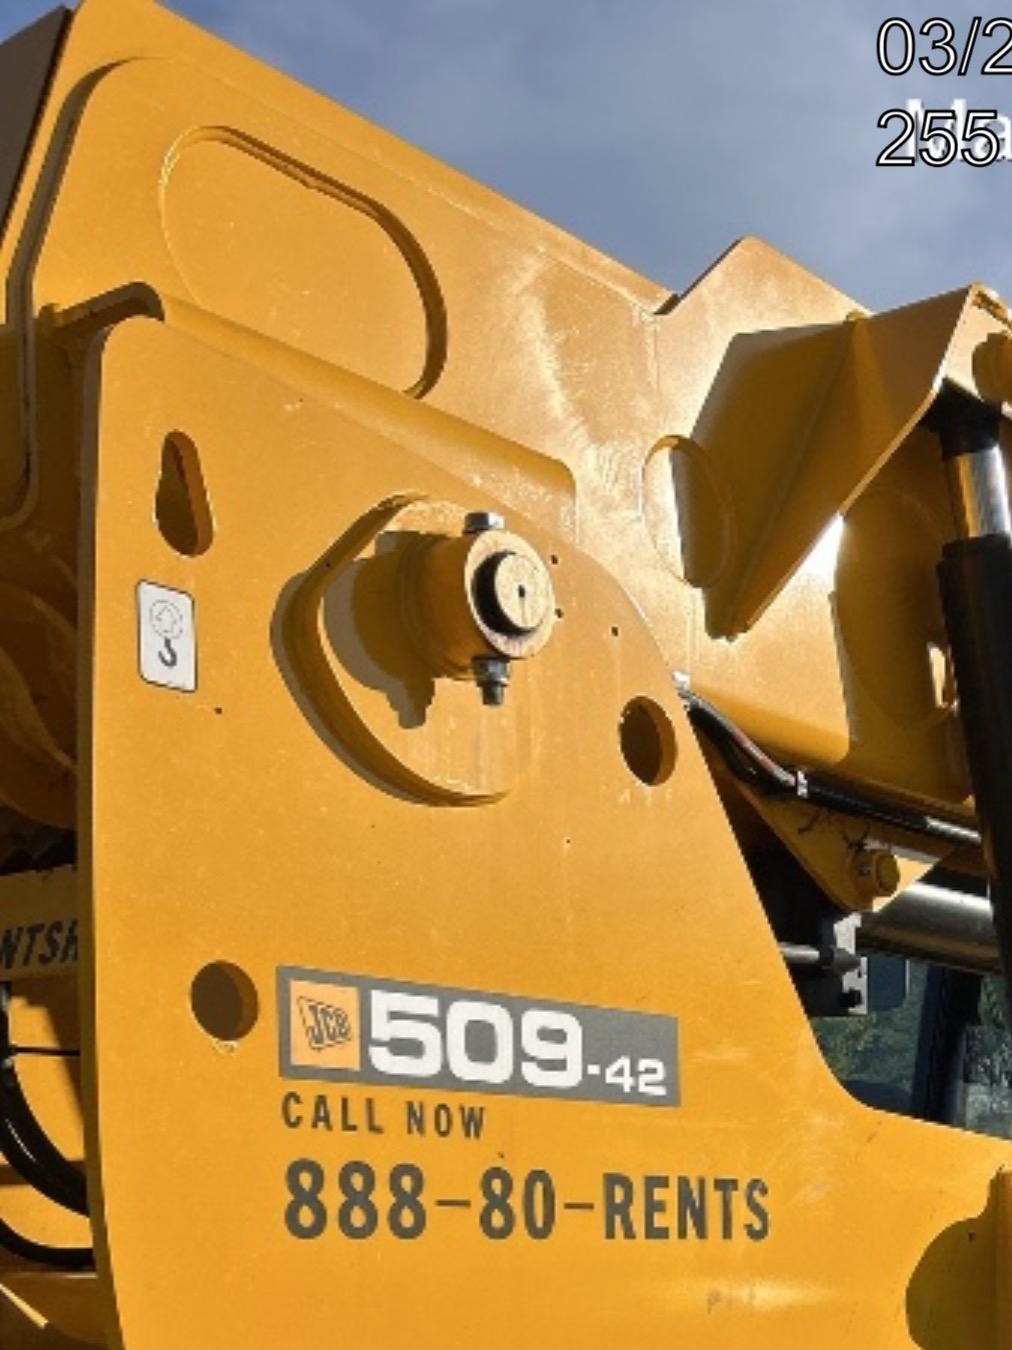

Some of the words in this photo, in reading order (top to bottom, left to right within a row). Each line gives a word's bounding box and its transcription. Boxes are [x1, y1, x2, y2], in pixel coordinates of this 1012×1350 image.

[281, 1091, 384, 1134] CALL
[406, 1100, 487, 1139] NOW
[284, 1157, 770, 1241] 888-80-RENTS
